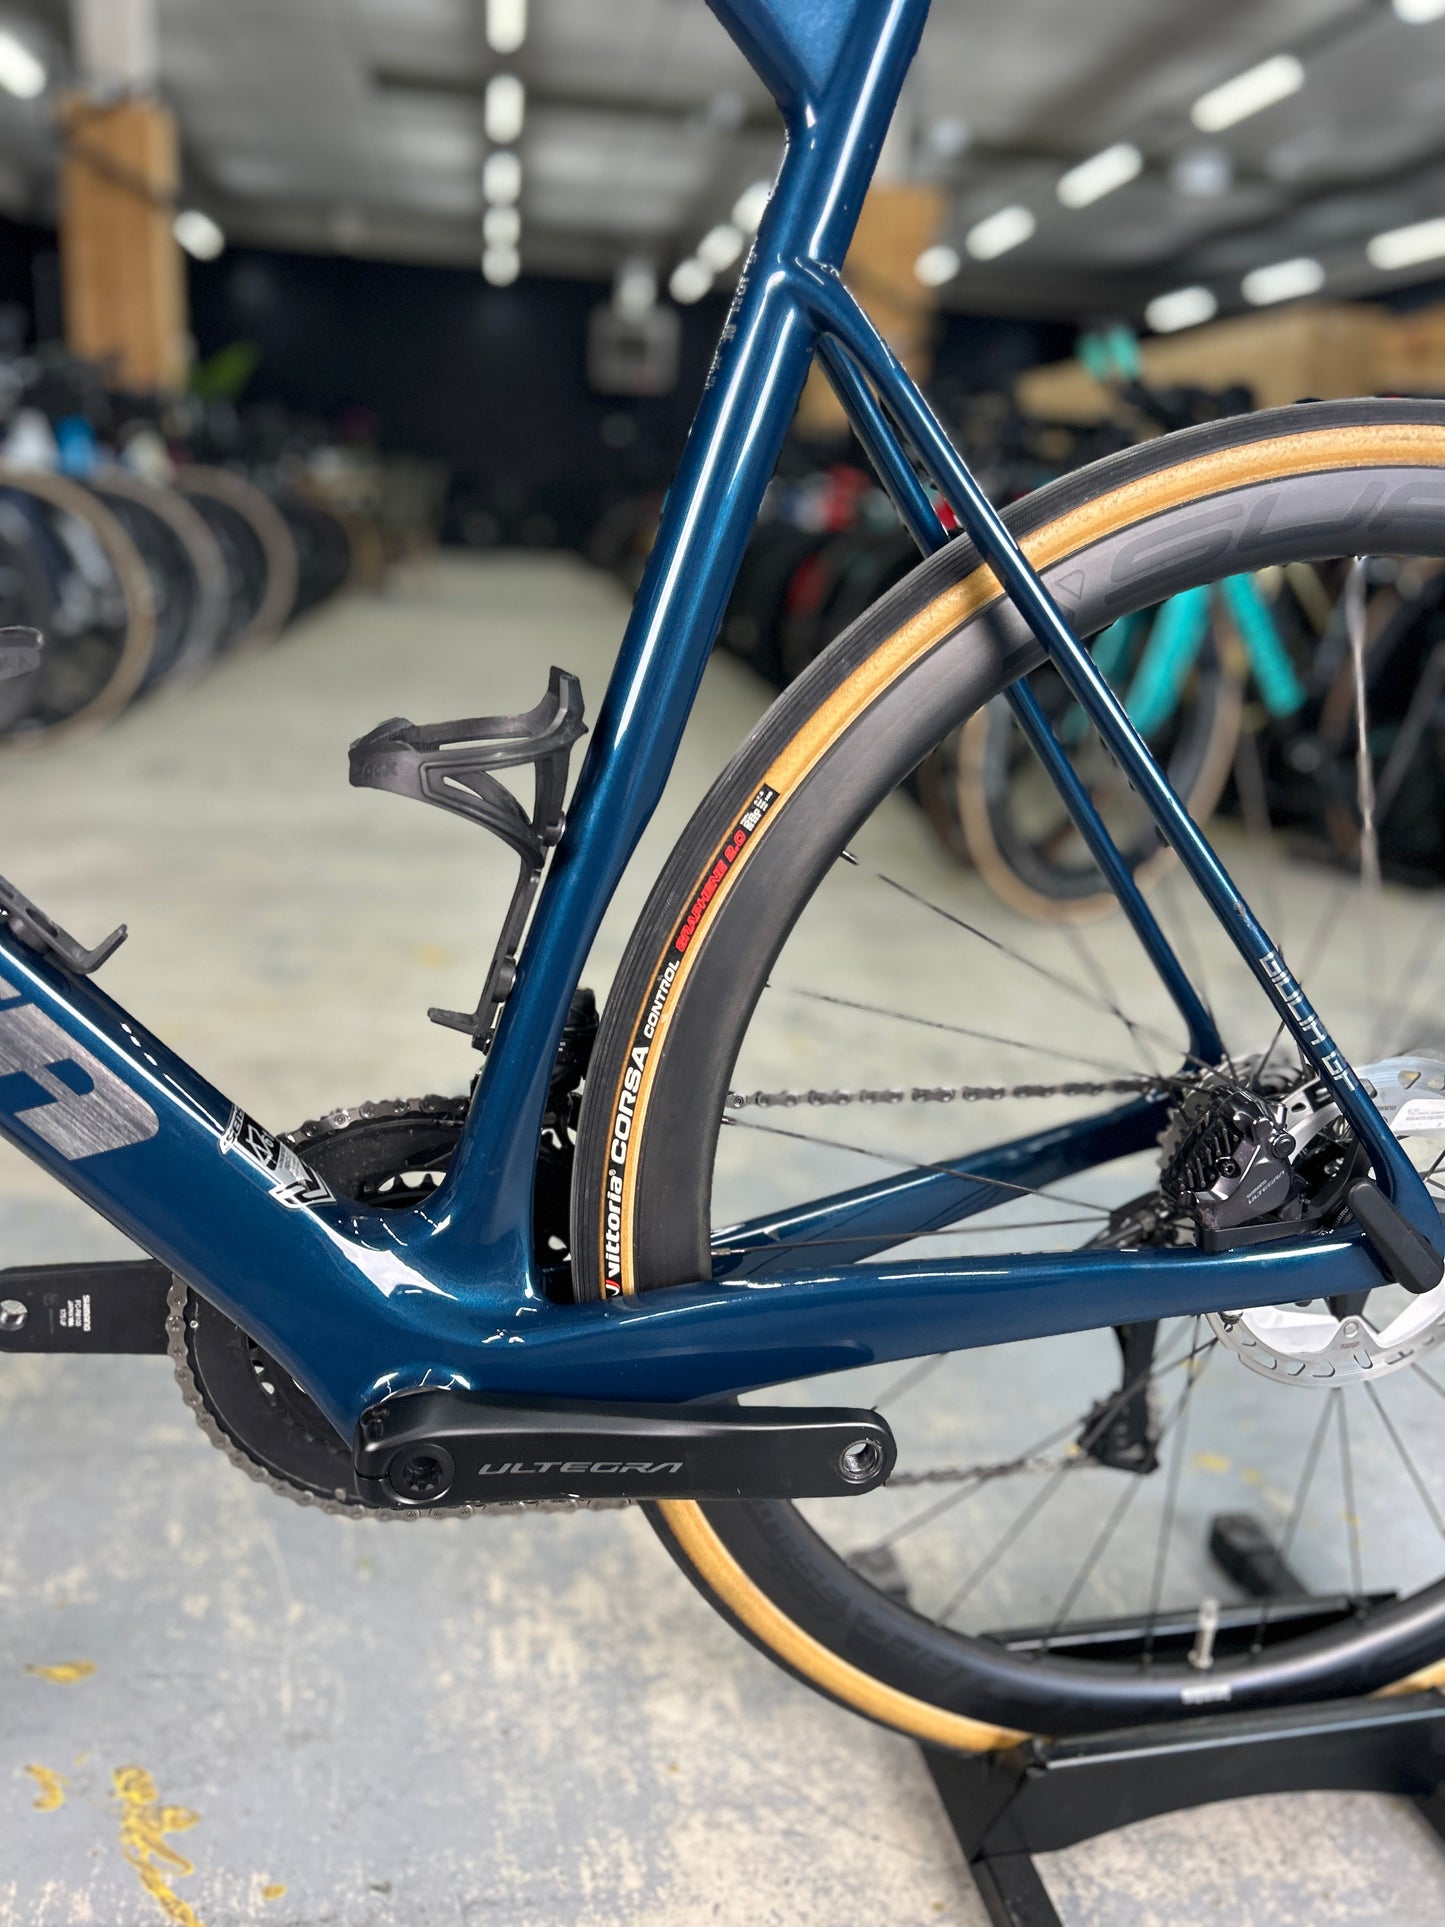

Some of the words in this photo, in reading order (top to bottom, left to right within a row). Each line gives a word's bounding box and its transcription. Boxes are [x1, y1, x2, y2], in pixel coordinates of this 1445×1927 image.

[610, 1046, 650, 1165] CORSA
[643, 959, 680, 1039] CONTROL
[675, 859, 728, 953] GRAPHENE
[724, 829, 746, 863] 2.0
[82, 1294, 91, 1332] SHIMANO
[478, 1461, 684, 1476] ULTEGRA
